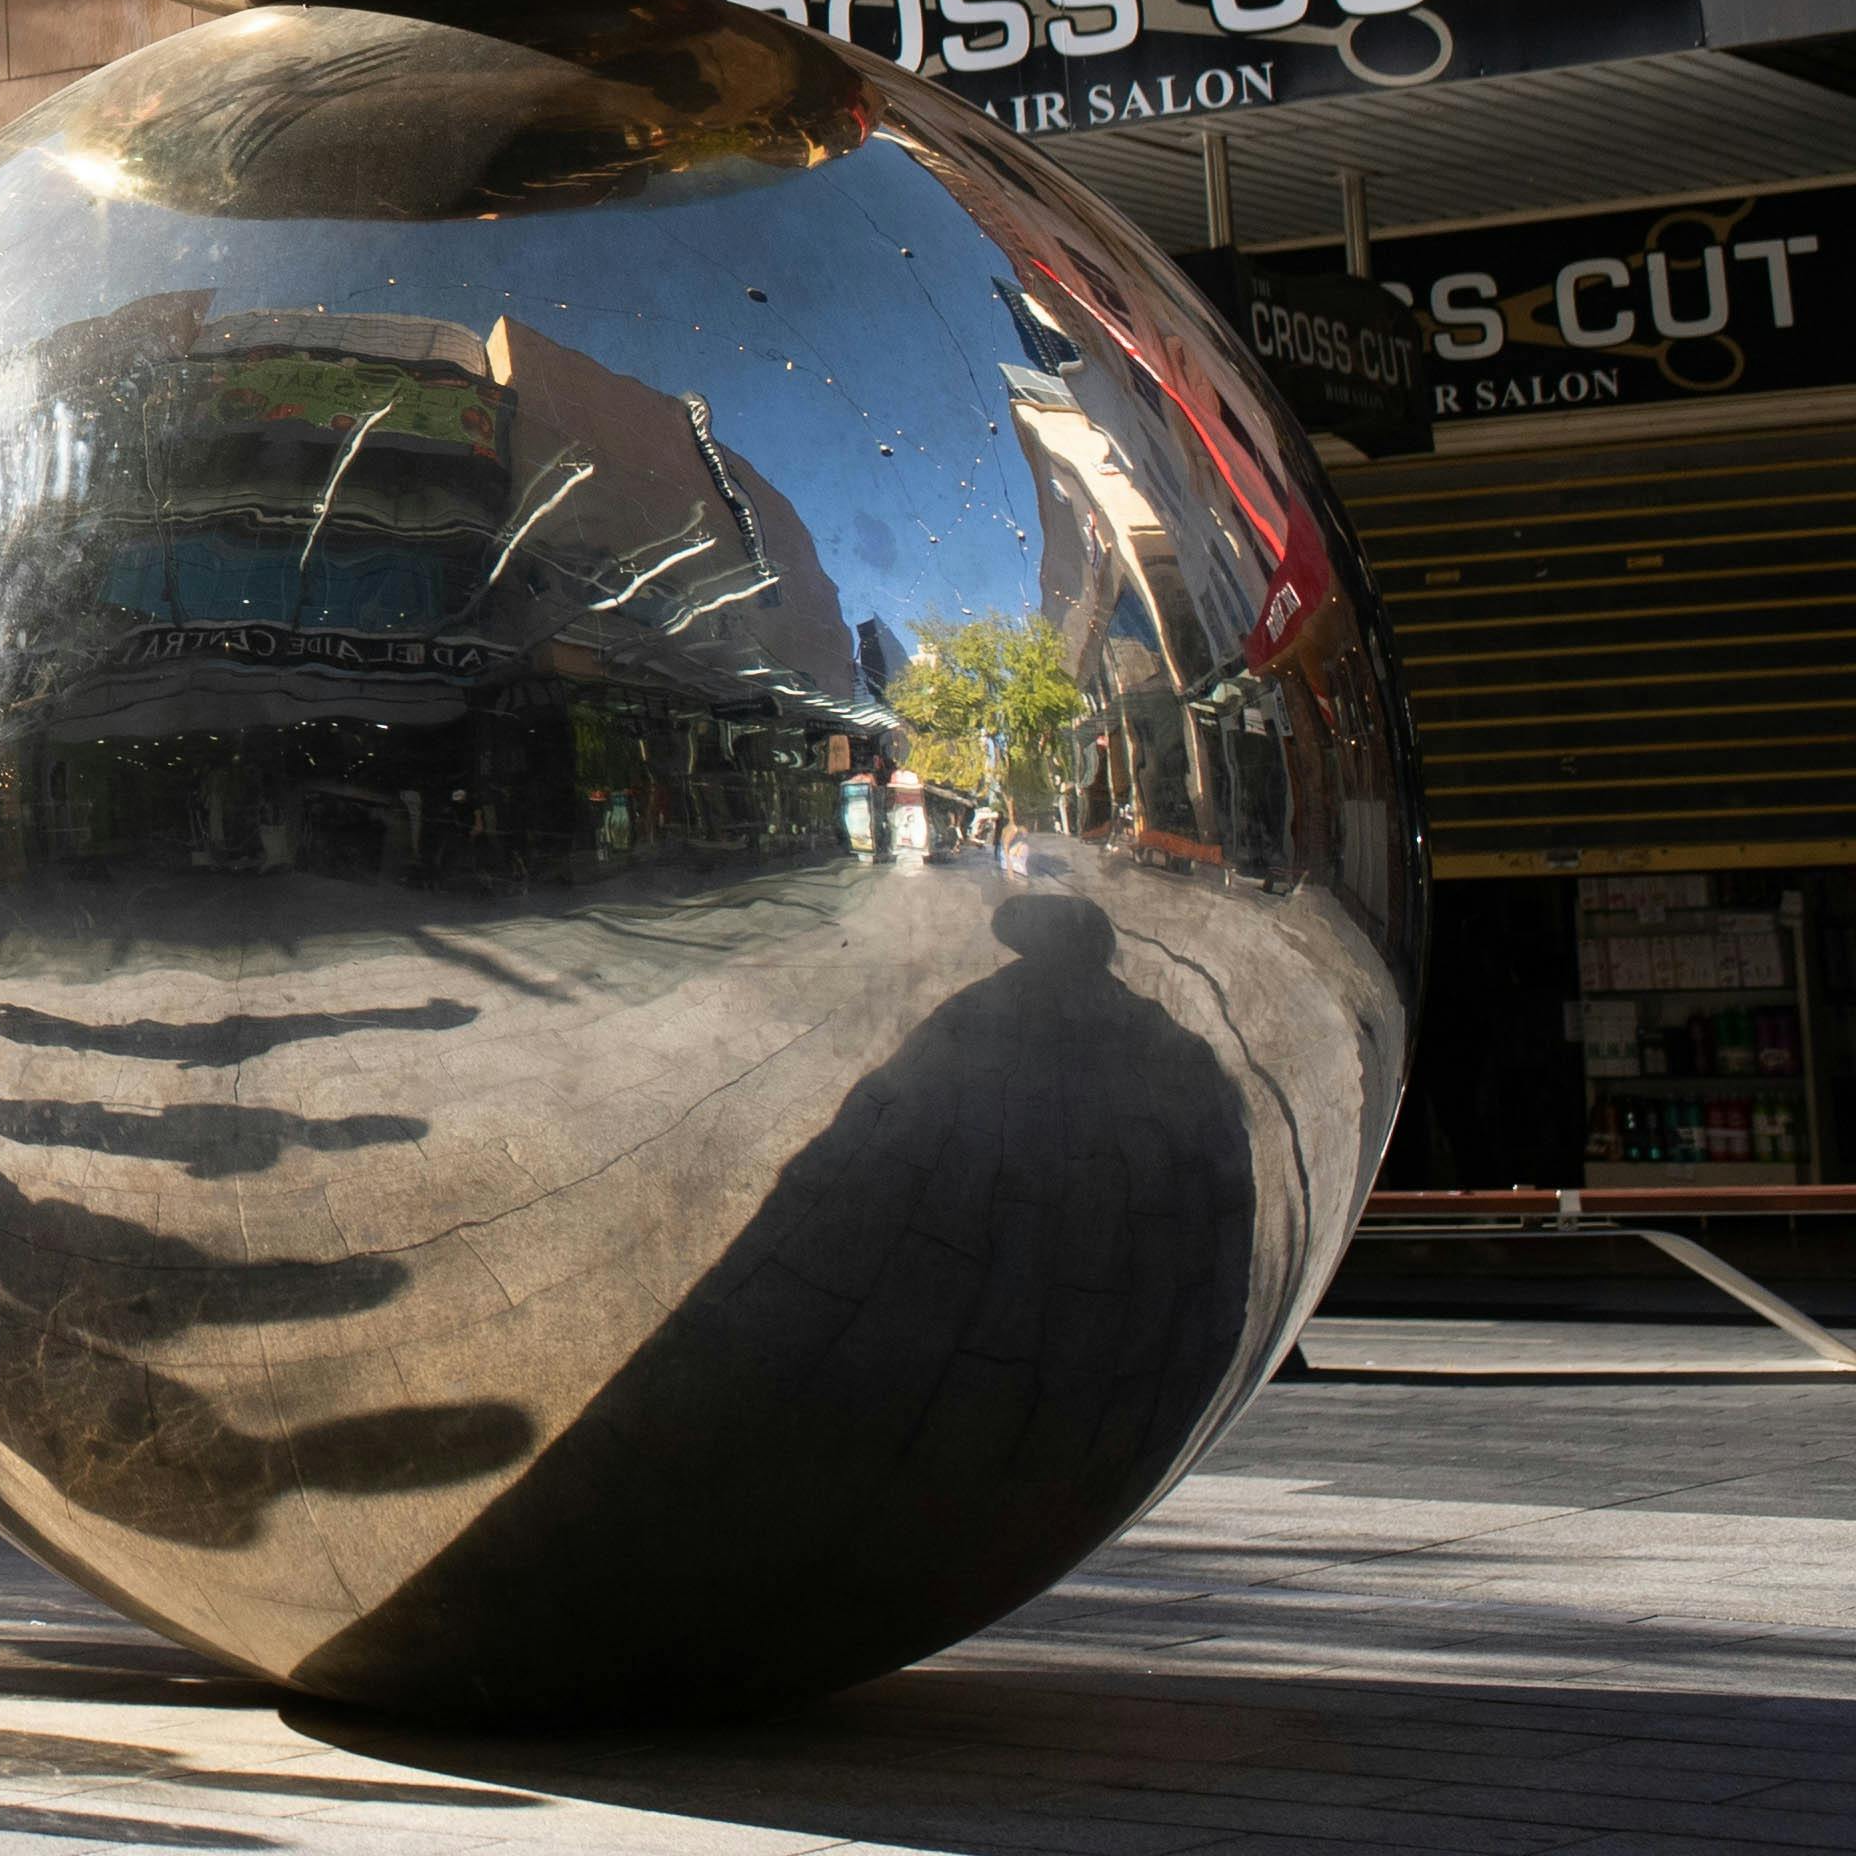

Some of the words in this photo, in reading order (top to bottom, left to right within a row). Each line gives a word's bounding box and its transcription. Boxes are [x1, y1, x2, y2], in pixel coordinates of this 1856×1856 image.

[1088, 62, 1274, 126] SALON
[1555, 234, 1820, 349] CUT
[1250, 301, 1353, 375] CROSS
[1359, 329, 1415, 389] CUT
[1475, 367, 1623, 413] SALON
